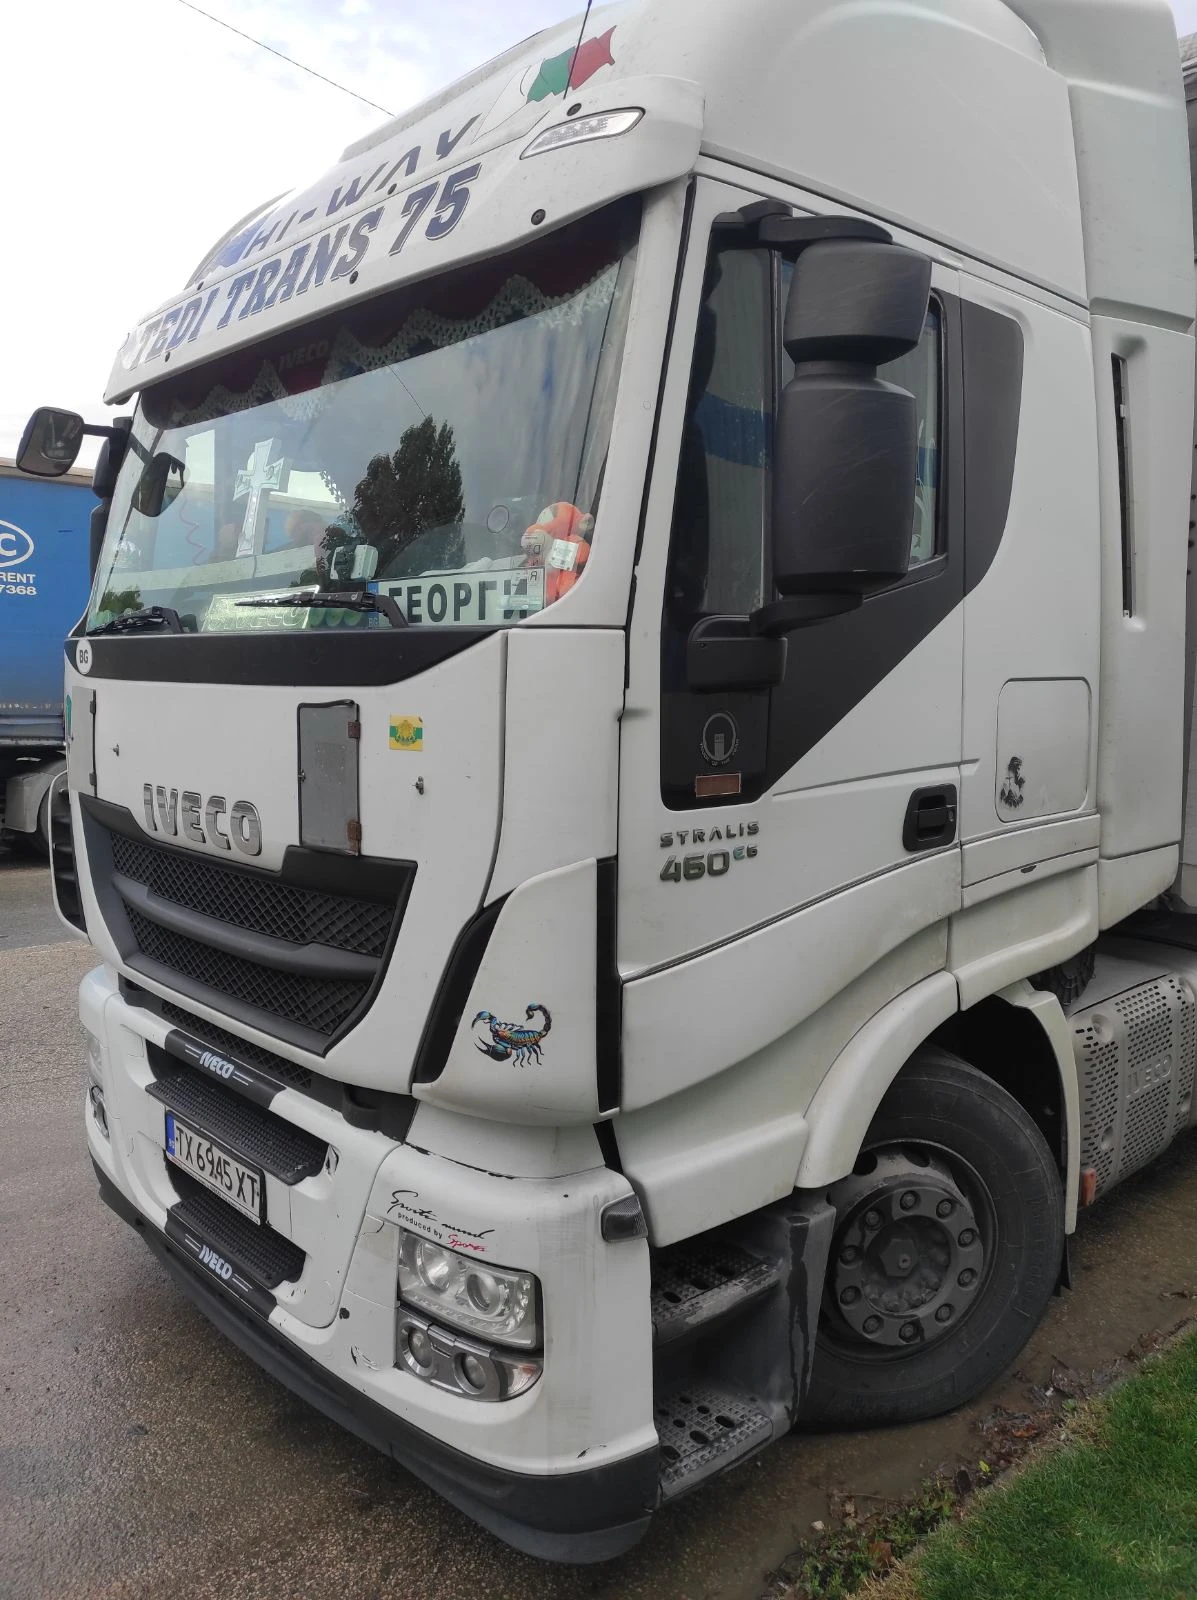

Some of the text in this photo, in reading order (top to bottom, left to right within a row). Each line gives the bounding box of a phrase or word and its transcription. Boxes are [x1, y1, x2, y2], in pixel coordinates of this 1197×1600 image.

[242, 113, 482, 260] HI-WAY
[128, 163, 482, 372] TEDI TRANS 75
[79, 649, 89, 664] BG
[143, 782, 263, 857] IVECO
[659, 820, 760, 848] STRALIS
[659, 849, 731, 883] 460
[200, 1050, 235, 1079] IVECO
[397, 1211, 431, 1233] produced
[433, 1229, 443, 1240] by
[198, 1244, 234, 1280] IVECO
